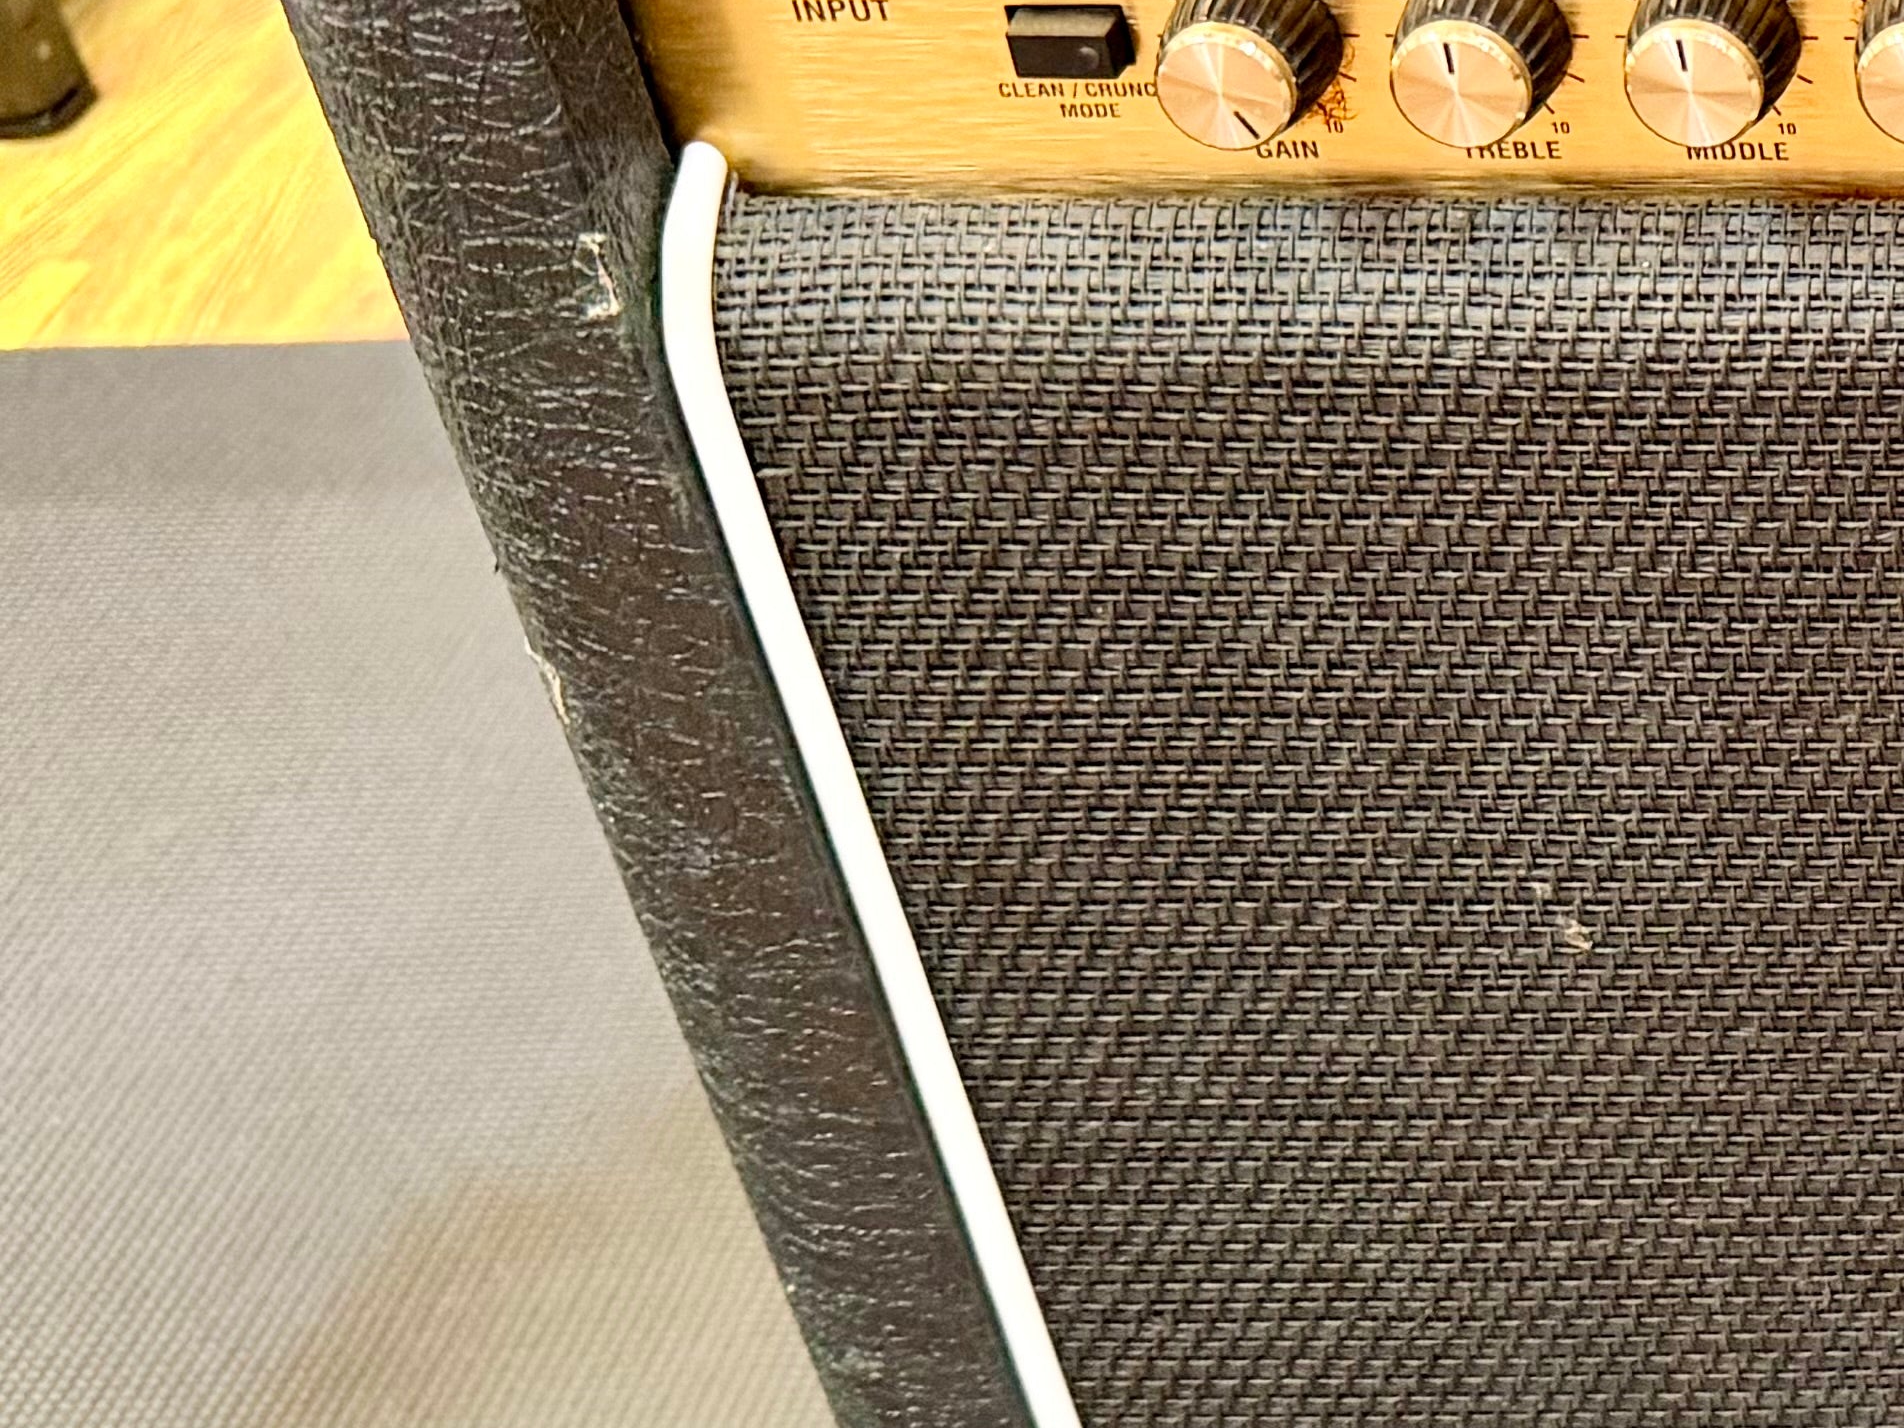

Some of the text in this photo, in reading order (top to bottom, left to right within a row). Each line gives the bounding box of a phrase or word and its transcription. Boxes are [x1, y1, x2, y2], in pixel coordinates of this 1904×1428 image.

[999, 82, 1064, 98] CLEAN
[1086, 82, 1158, 98] CRUNC
[1060, 102, 1121, 118] MODE
[1552, 122, 1570, 134] 10
[1778, 123, 1797, 135] 10
[1256, 140, 1320, 159] GAIN
